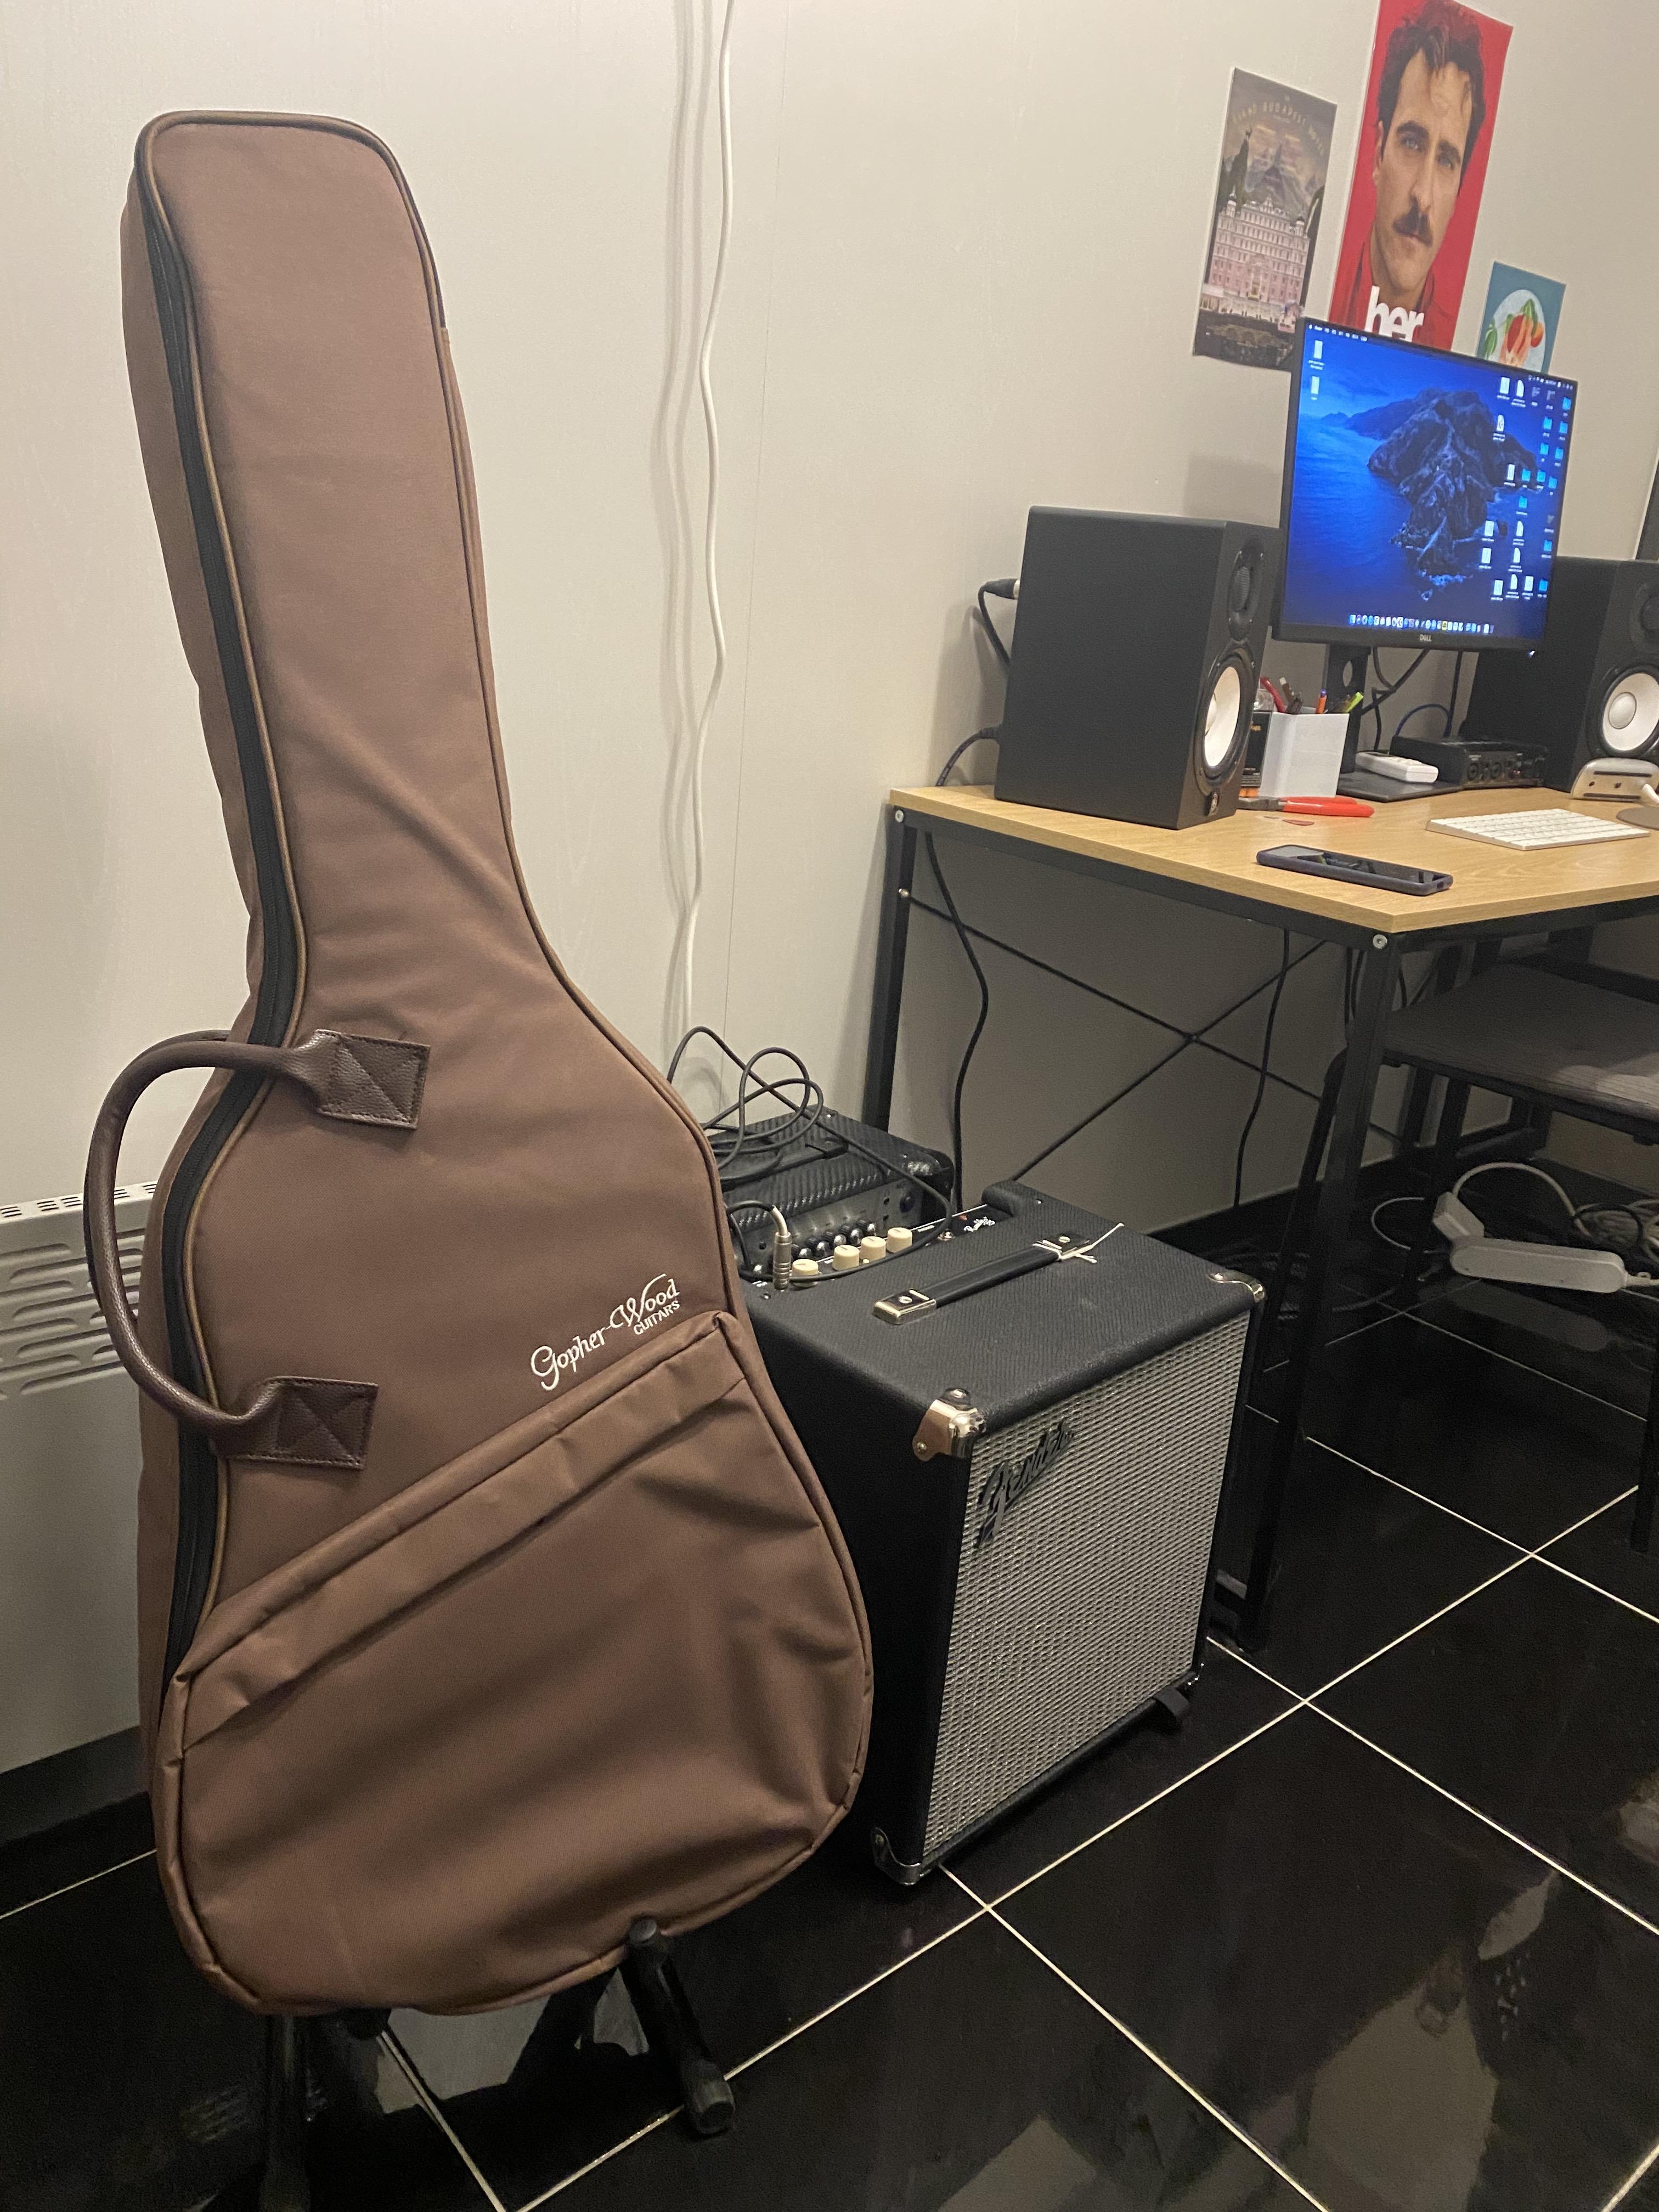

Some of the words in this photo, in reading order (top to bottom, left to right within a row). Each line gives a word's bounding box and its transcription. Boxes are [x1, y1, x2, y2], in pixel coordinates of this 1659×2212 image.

[1364, 285, 1425, 342] her
[531, 1327, 606, 1391] Gopher
[610, 1273, 680, 1327] Wood
[633, 1300, 680, 1335] GUITARS
[975, 1418, 1073, 1547] Fender
